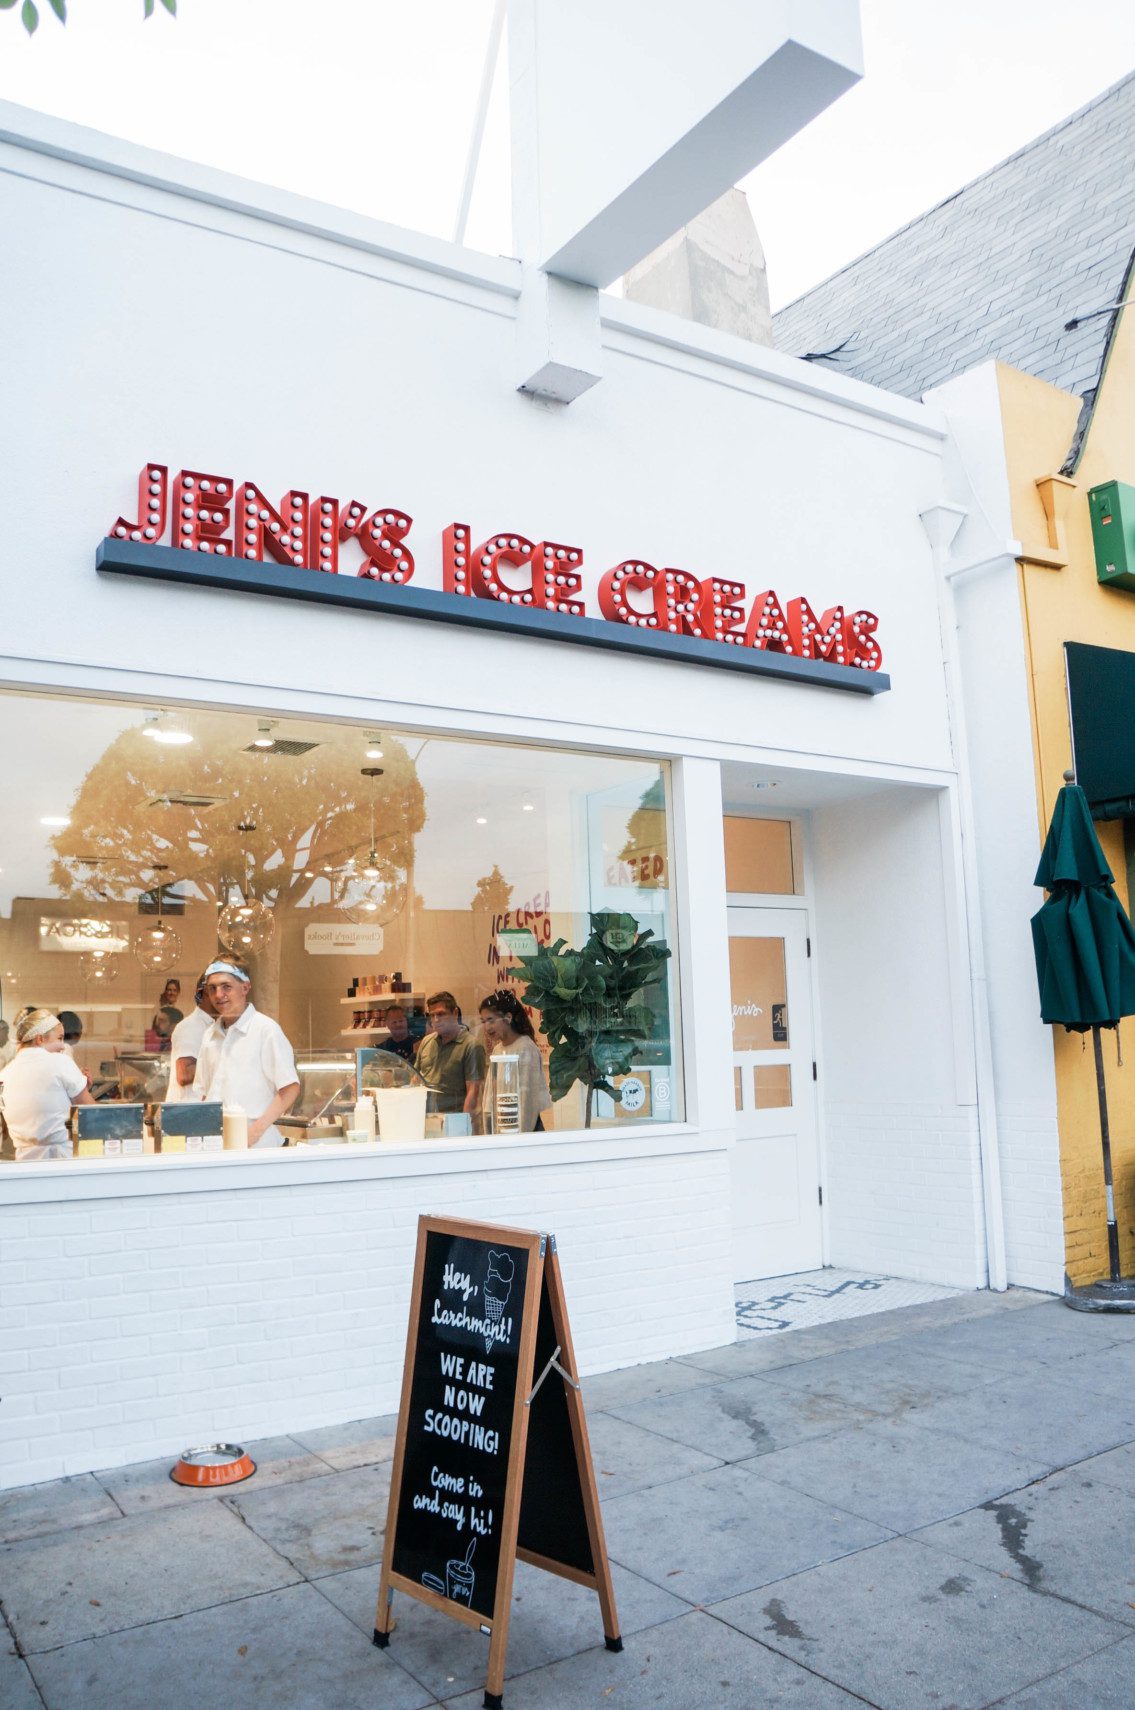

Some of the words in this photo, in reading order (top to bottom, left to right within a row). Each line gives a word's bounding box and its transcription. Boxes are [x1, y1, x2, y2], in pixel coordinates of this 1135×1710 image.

[109, 463, 415, 585] JENI'S
[442, 522, 586, 617] ICE
[598, 559, 882, 672] CREAMS
[442, 1262, 479, 1302] Hey,
[440, 1351, 465, 1381] WE
[466, 1361, 495, 1391] ARE
[443, 1384, 486, 1417] NOW
[423, 1408, 499, 1455] SCOOPING!
[430, 1465, 465, 1494] Come
[468, 1475, 483, 1498] in
[413, 1490, 441, 1514] and
[441, 1502, 466, 1532] say
[470, 1506, 493, 1536] hi!
